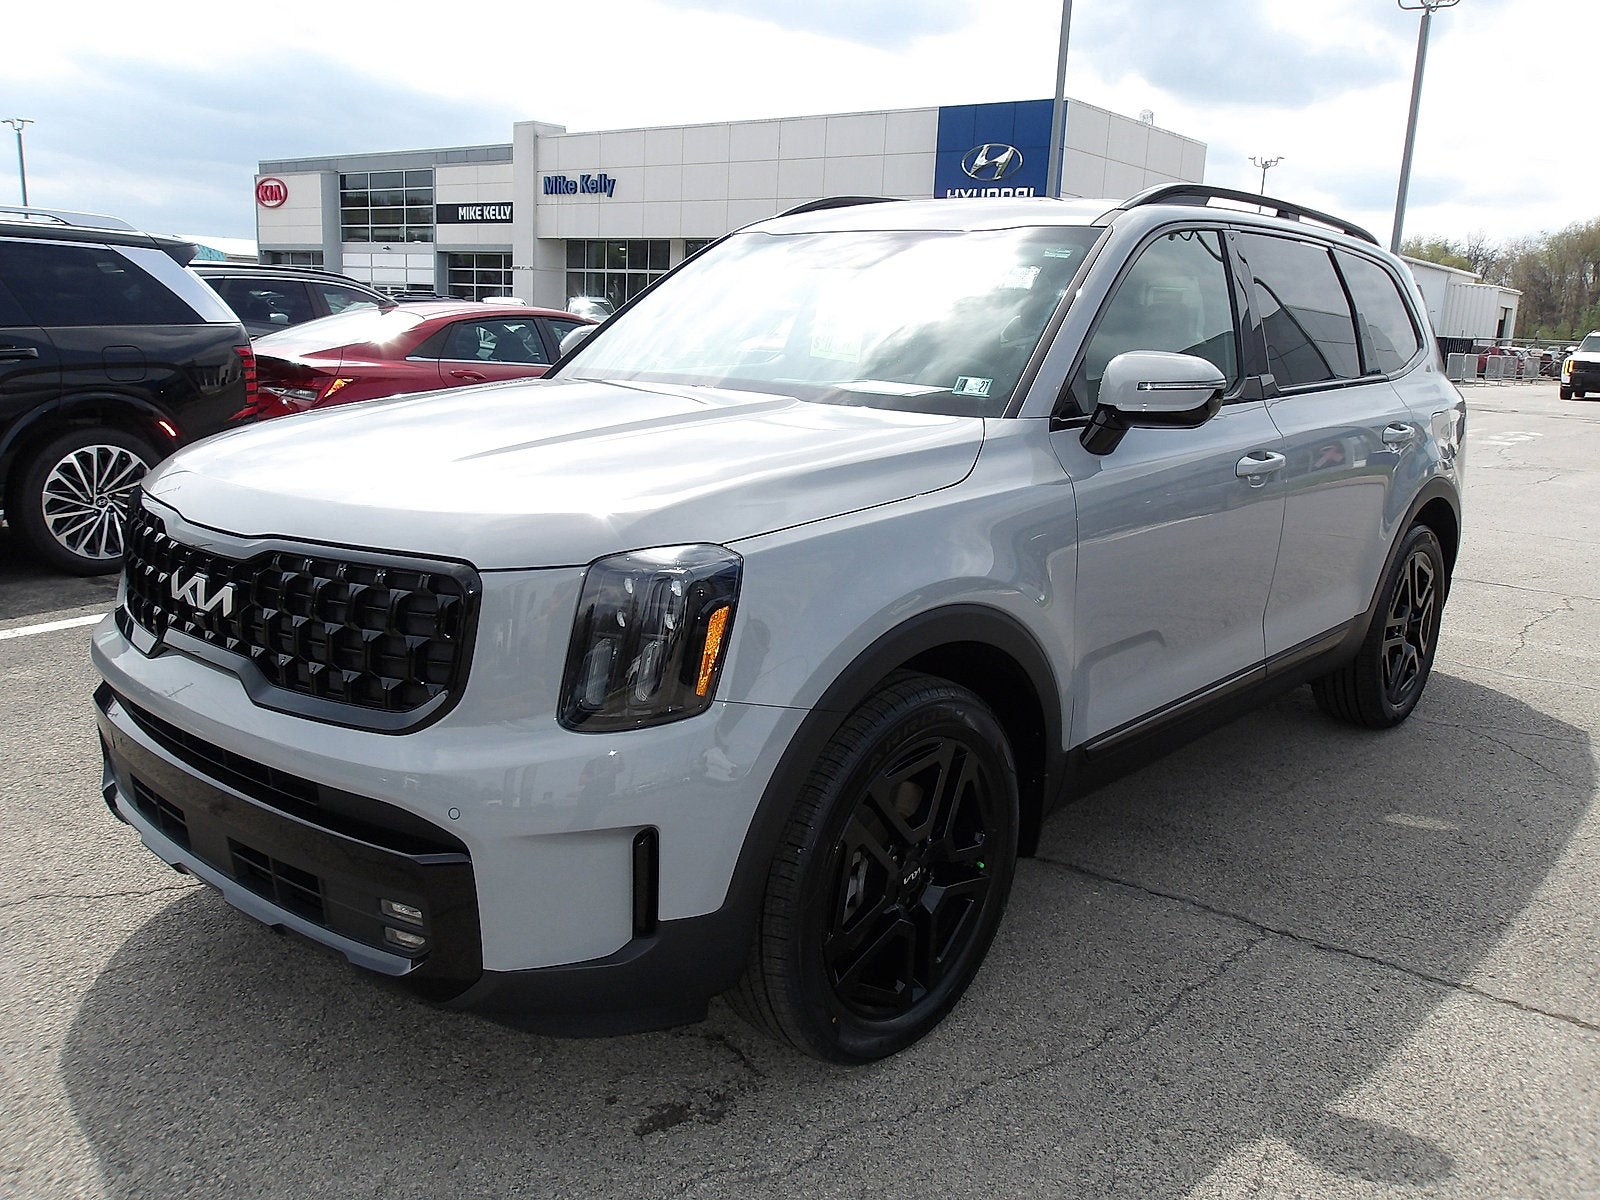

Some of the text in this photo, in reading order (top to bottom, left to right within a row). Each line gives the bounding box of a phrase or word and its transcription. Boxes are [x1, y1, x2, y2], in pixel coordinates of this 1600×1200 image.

[258, 184, 283, 202] KIA
[543, 173, 617, 198] Mike Kelly
[458, 205, 512, 221] MIKE KELLY
[978, 380, 990, 393] 27
